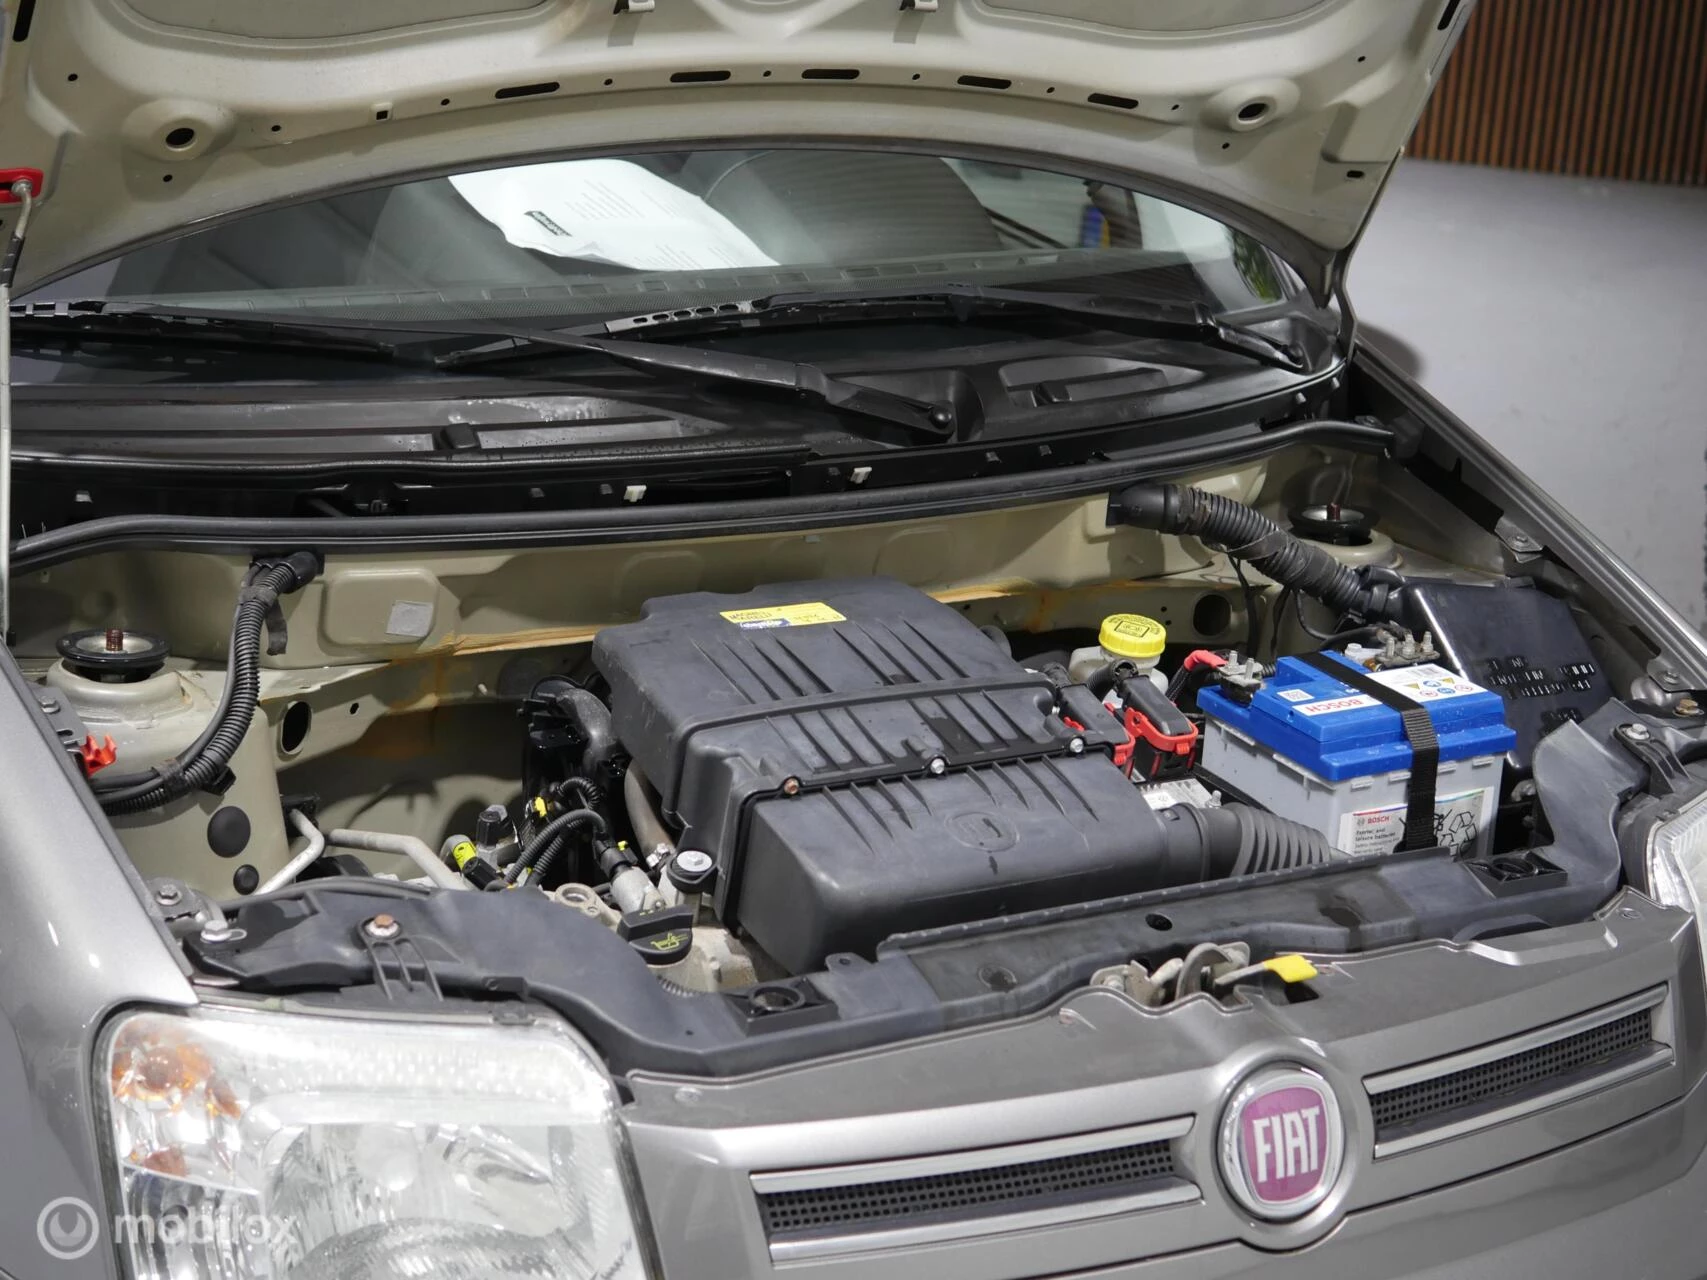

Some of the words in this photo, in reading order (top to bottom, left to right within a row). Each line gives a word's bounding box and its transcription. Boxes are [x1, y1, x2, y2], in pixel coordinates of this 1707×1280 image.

[1305, 699, 1364, 713] BOSCH
[1368, 816, 1390, 824] BOSCH
[1253, 1106, 1320, 1183] FIAT
